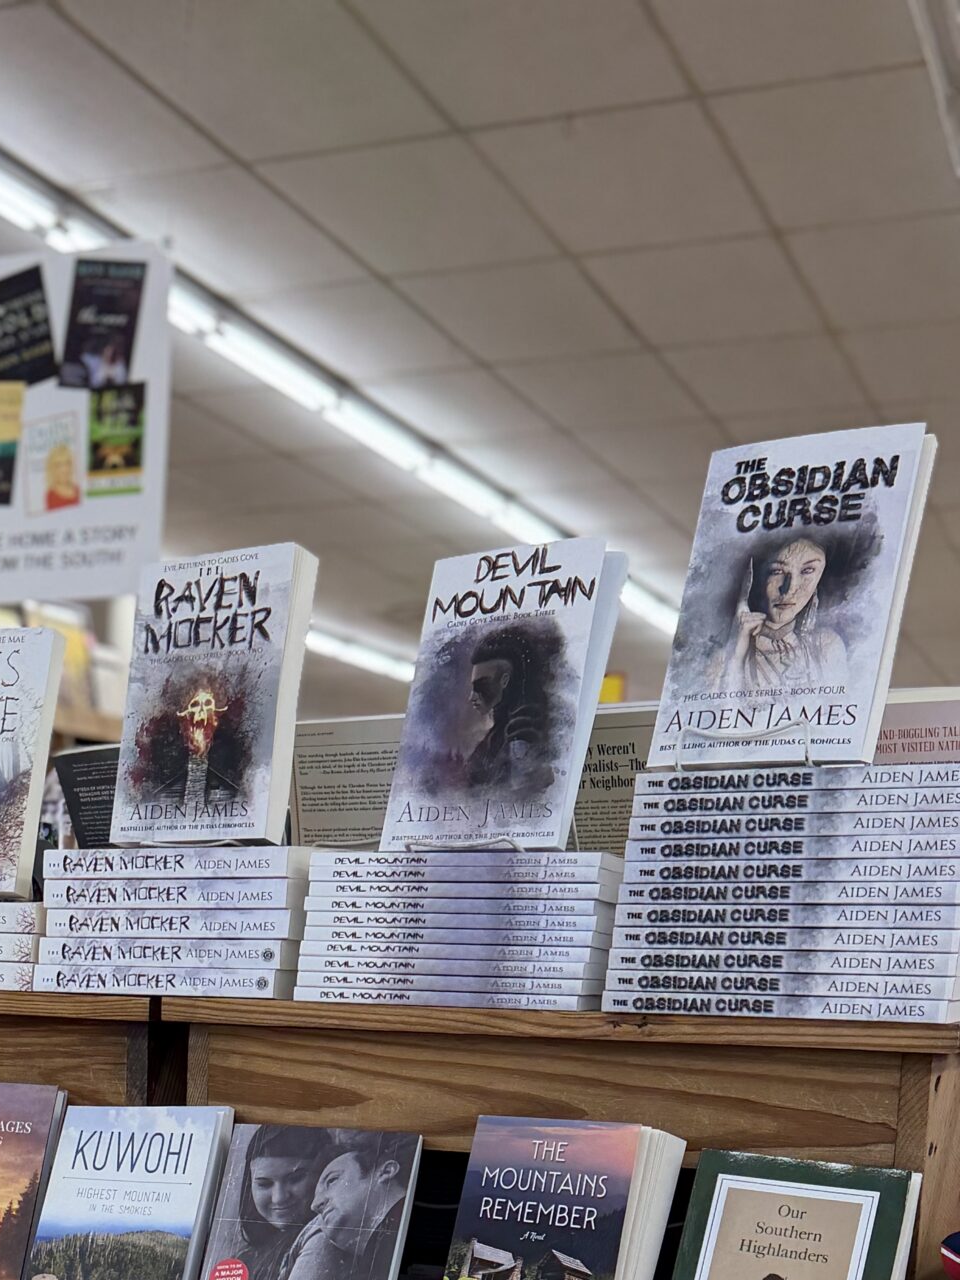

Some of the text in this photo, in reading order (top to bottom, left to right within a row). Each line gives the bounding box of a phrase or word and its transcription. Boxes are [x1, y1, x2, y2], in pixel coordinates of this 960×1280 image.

[735, 458, 768, 475] THE
[720, 455, 900, 505] OBSIDIAN
[736, 494, 865, 532] CURSE
[7, 531, 56, 548] HOME
[81, 526, 138, 543] STORY
[24, 555, 56, 570] THE
[474, 544, 561, 584] DEVIL
[154, 570, 260, 619] RAVEN
[144, 607, 272, 654] MOCKER
[729, 690, 754, 699] COVE
[756, 689, 783, 698] SERIES
[790, 687, 816, 696] BOOK
[818, 685, 845, 695] FOUR
[597, 742, 635, 755] Weren't
[130, 801, 248, 824] AIDEN JAMES
[649, 885, 942, 900] OBSIDIAN CURSE AIDEN JAMES
[71, 1130, 194, 1175] KUWOHI
[532, 1140, 568, 1162] THE
[480, 1166, 608, 1198] MOUNTAINS
[77, 1188, 171, 1203] HIGHEST MOUNTAIN
[479, 1198, 597, 1230] REMEMBER
[778, 1204, 807, 1221] Our
[754, 1222, 822, 1243] Southern
[739, 1238, 828, 1265] Highlanders
